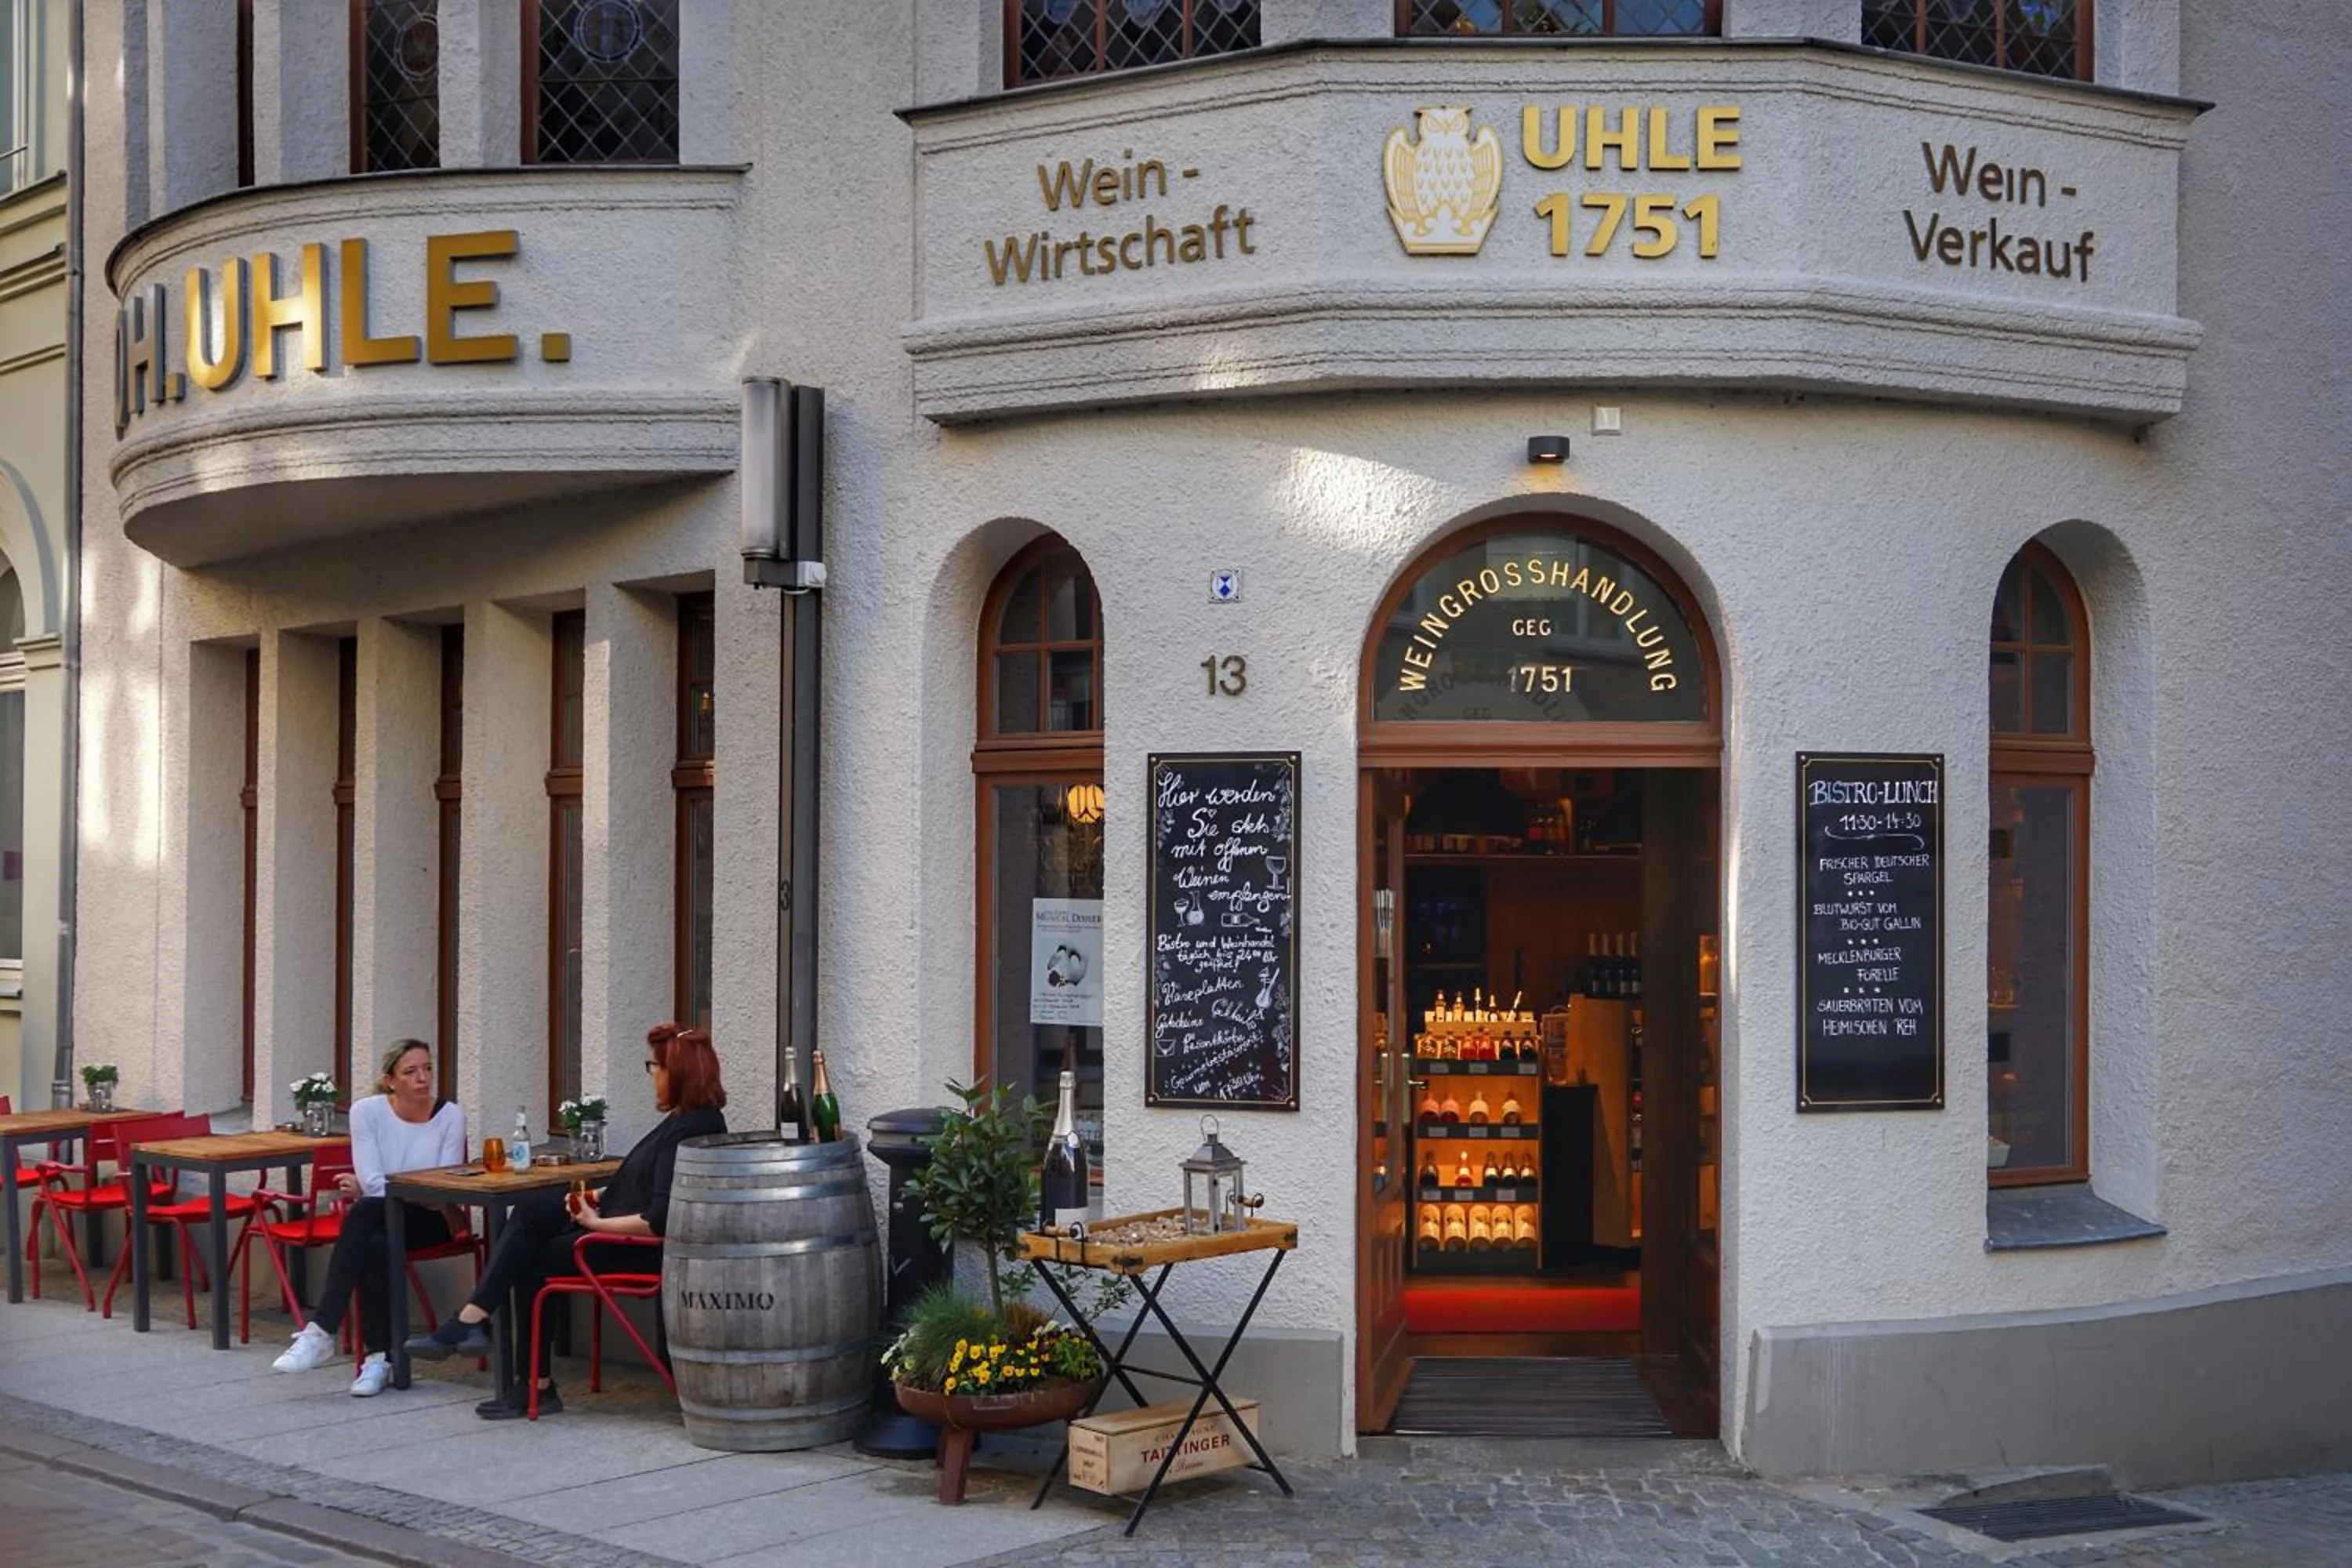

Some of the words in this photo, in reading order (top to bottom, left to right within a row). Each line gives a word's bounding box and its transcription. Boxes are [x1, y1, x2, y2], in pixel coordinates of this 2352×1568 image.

[1522, 106, 1742, 170] UHLE
[1037, 148, 1167, 211] Wein
[1922, 141, 2046, 207] Wein
[1533, 192, 1721, 259] 1751
[985, 205, 1254, 285] Wirtschaft
[1904, 208, 2094, 282] Verkauf
[1399, 558, 1678, 692] WEINGROSSHANDLUNG
[1512, 618, 1552, 636] GEG
[1201, 655, 1247, 696] 13
[1507, 666, 1573, 693] 1751
[1158, 772, 1200, 808] Hier
[1205, 779, 1276, 805] werden
[1808, 780, 1938, 806] BISTRO-LUNCH
[1187, 808, 1219, 838] Sie
[1171, 839, 1206, 858] mit
[1820, 855, 1868, 871] FRISCHER
[1874, 854, 1929, 868] DEUTSCHER
[1844, 871, 1893, 885] SPARGEL
[1813, 902, 1874, 916] BLUTWURST
[1157, 932, 1191, 952] Bistro
[1196, 936, 1216, 948] und
[681, 1291, 775, 1311] MAXIMO
[1142, 1434, 1231, 1463] TAIINGER
